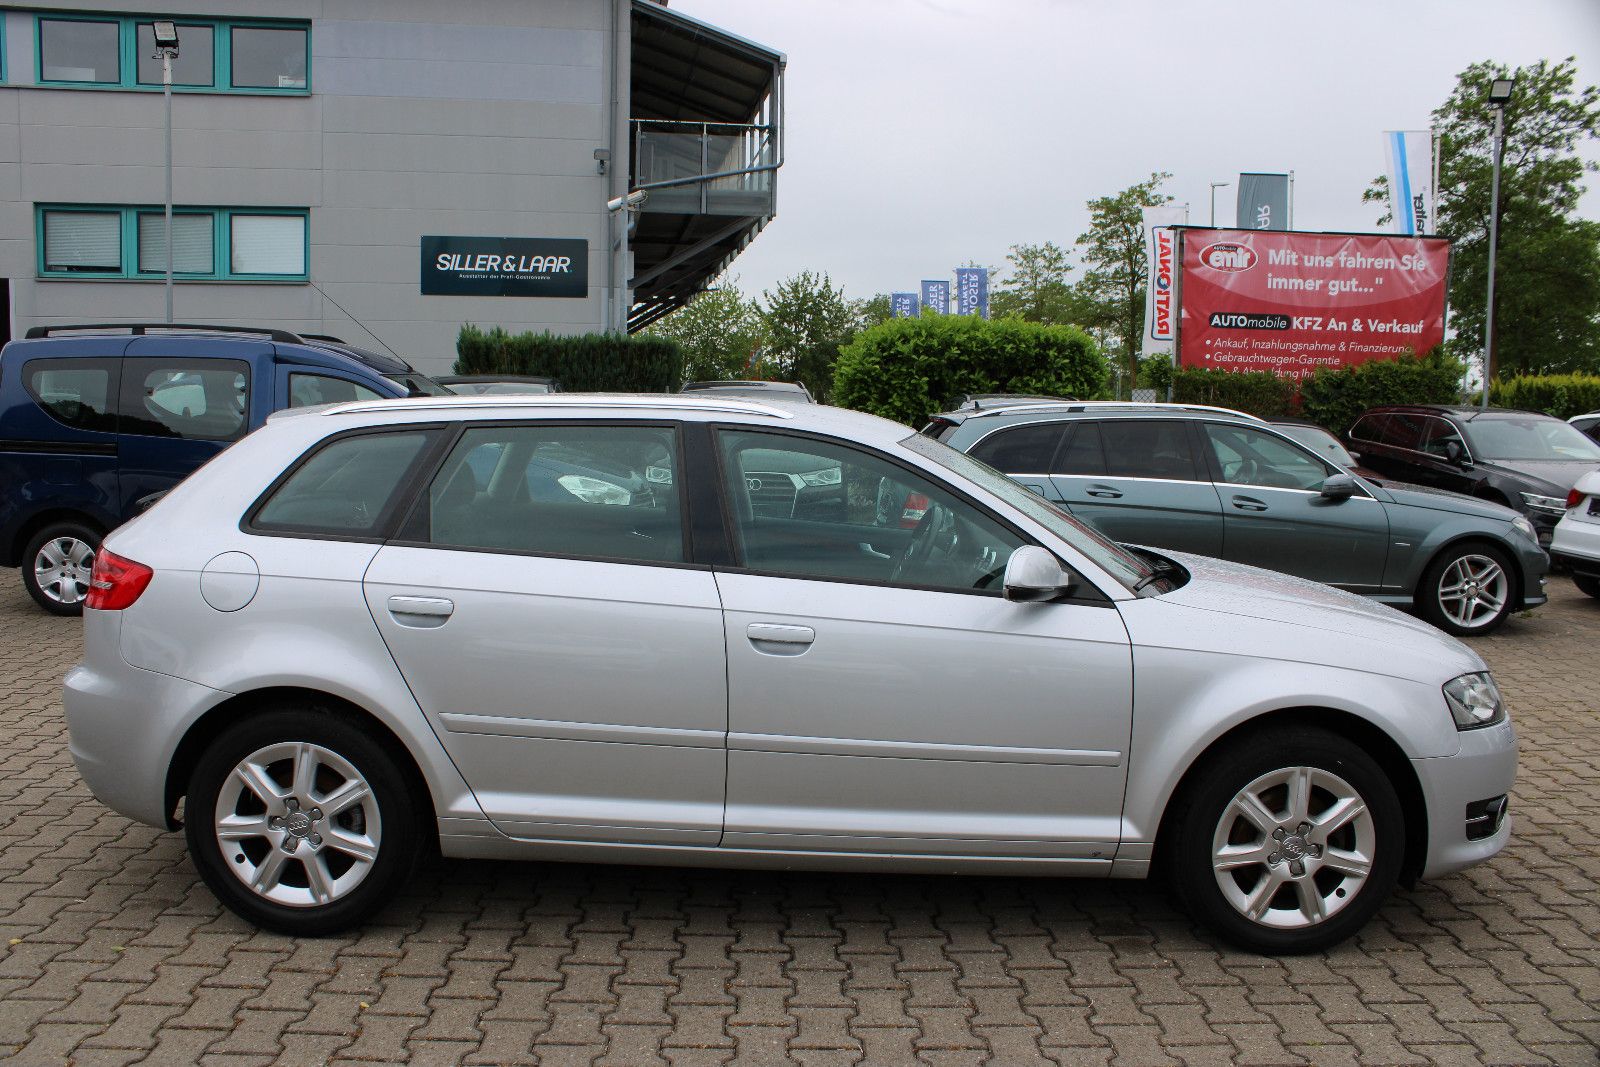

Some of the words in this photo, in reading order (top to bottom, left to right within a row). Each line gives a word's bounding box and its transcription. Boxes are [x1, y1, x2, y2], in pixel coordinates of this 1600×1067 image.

[436, 253, 501, 272] SILLER
[503, 254, 516, 272] &
[519, 255, 571, 273] LAAR
[1209, 247, 1250, 267] emir
[1268, 249, 1298, 266] Mit
[1303, 255, 1333, 267] uns
[1339, 252, 1395, 270] fahren
[1399, 254, 1426, 271] Sie
[1267, 273, 1323, 291] immer
[1211, 314, 1287, 329] AUTOmobile
[1292, 316, 1323, 330] KFZ
[1327, 318, 1347, 331] An
[1352, 318, 1363, 332] &
[1368, 319, 1424, 333] Verkauf
[1213, 338, 1249, 350] Ankauf,
[1251, 339, 1336, 353] Inzahlungsnahme
[1338, 341, 1346, 352] &
[1213, 351, 1340, 366] Gebrauchtwagen-Garantie
[1243, 366, 1299, 380] Abmldung
